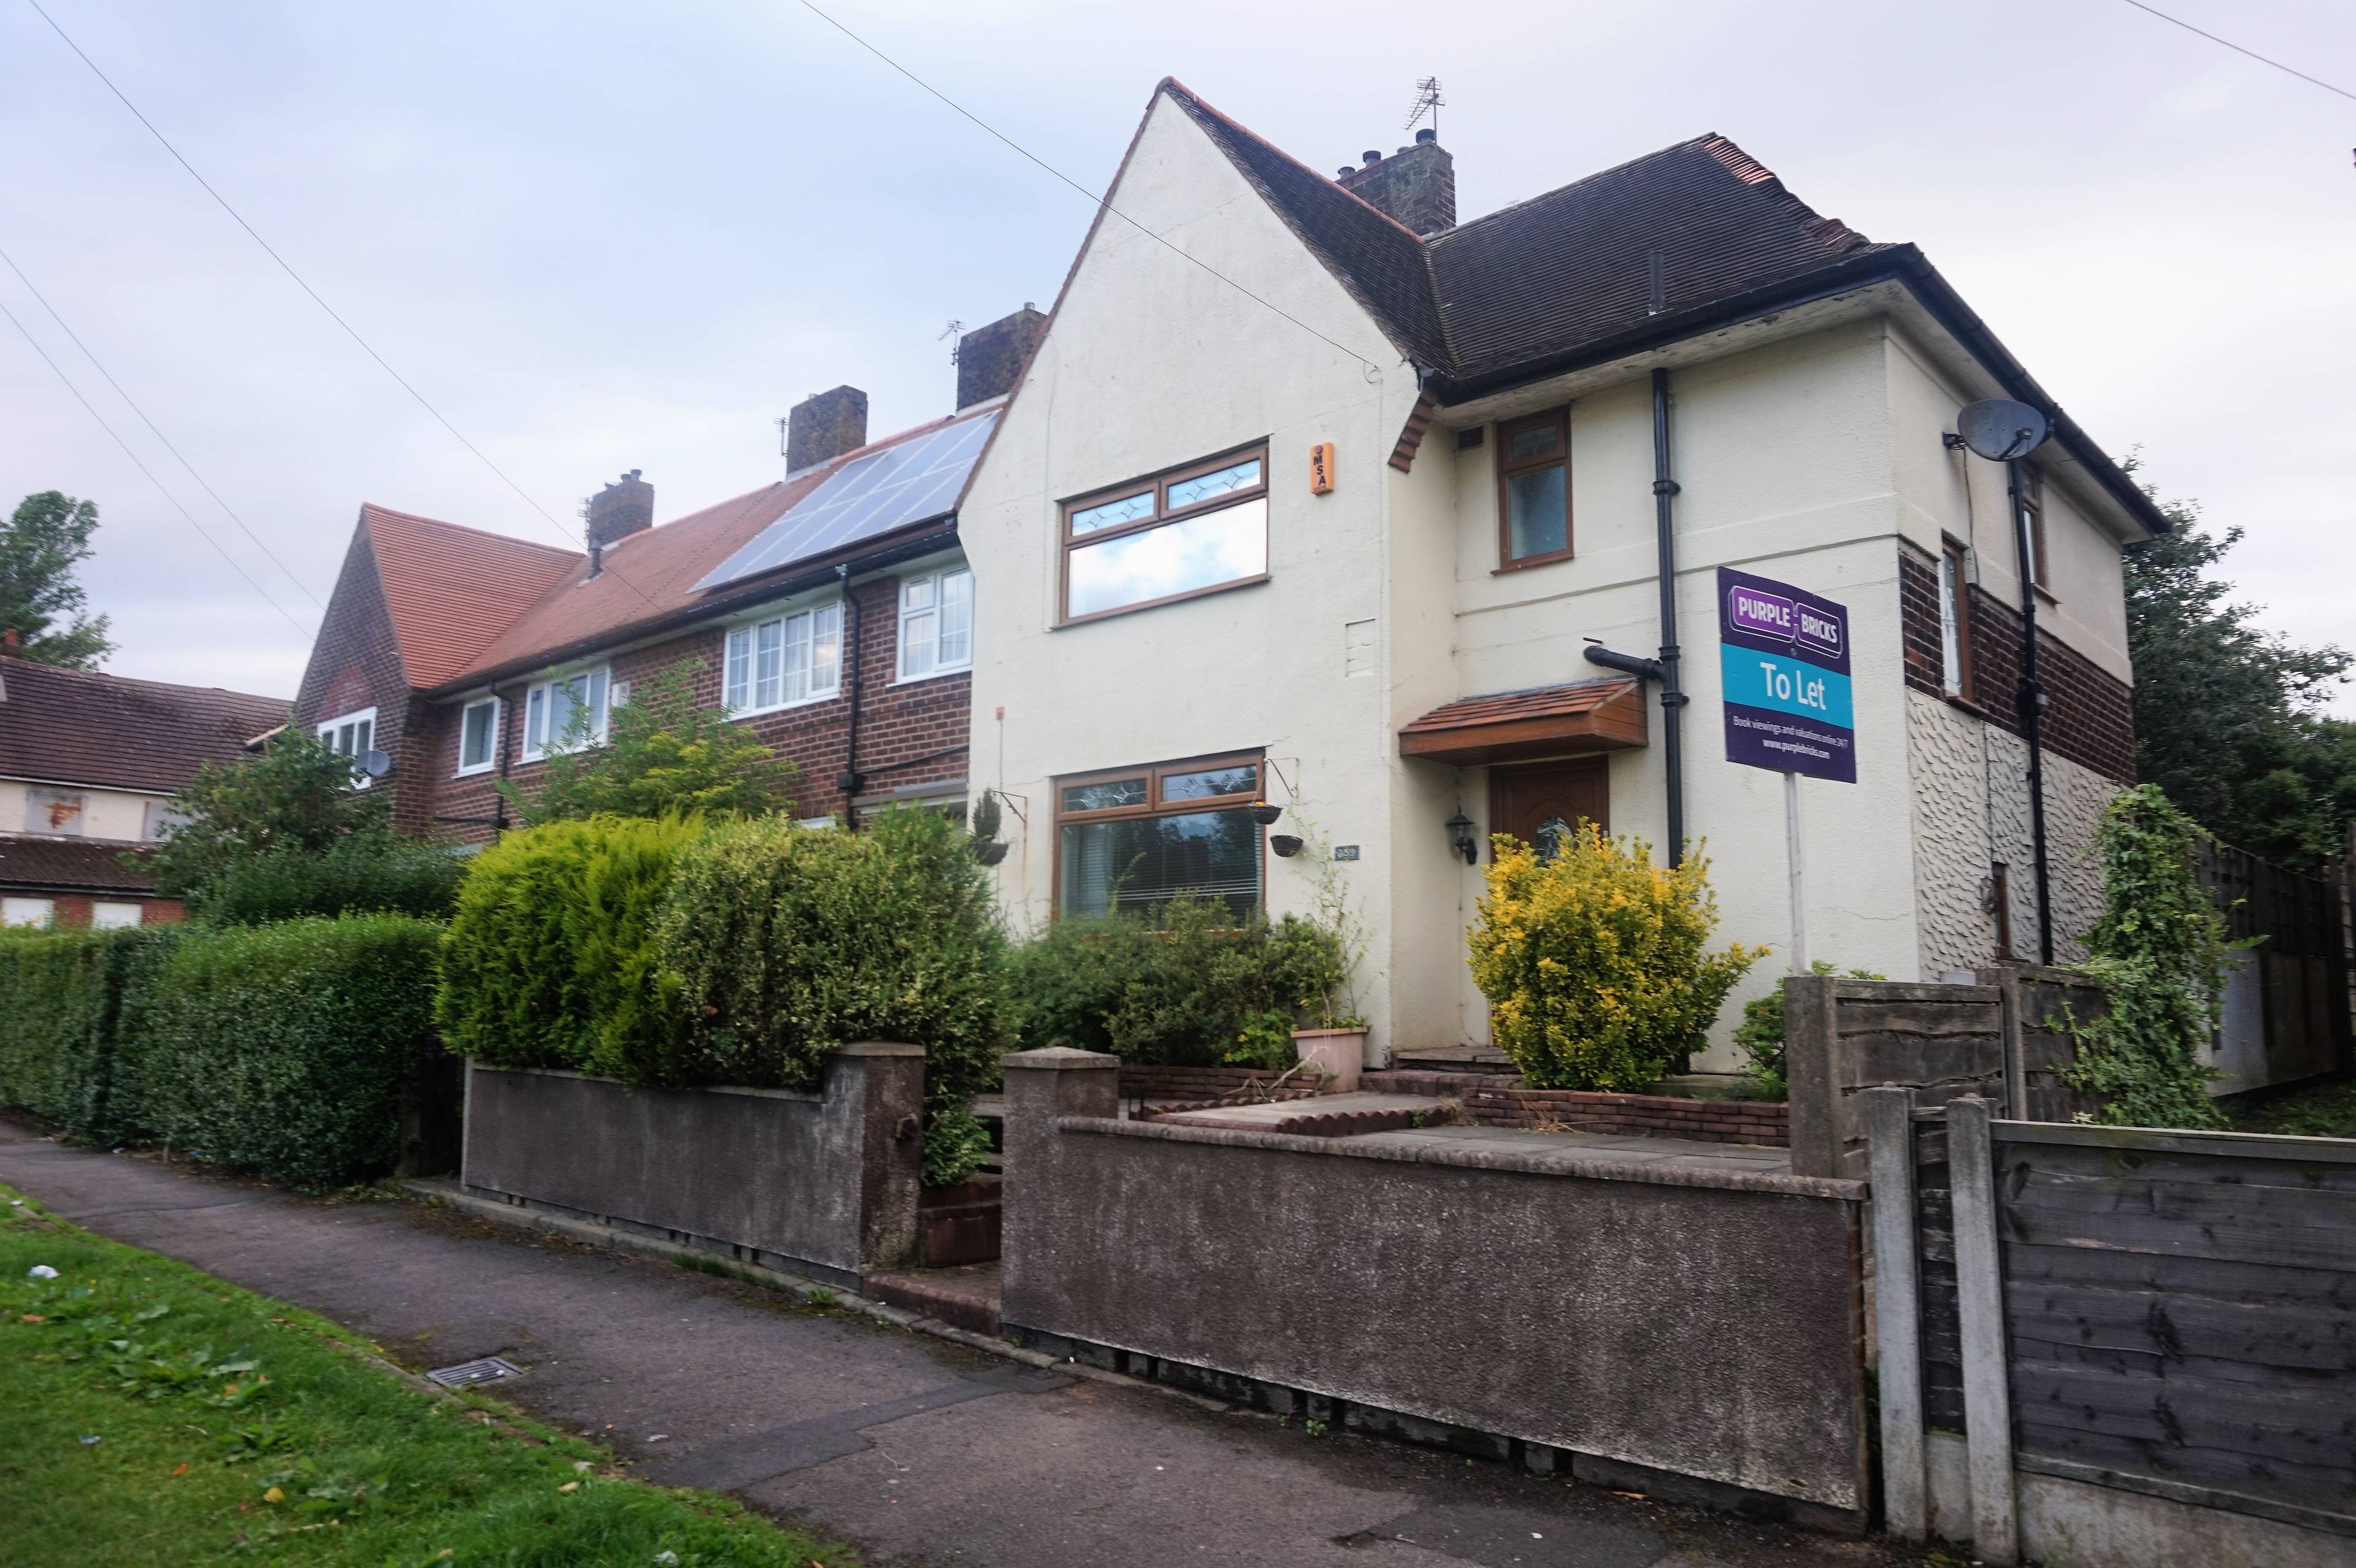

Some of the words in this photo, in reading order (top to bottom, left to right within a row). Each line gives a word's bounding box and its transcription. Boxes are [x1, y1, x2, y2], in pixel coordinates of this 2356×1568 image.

[1314, 455, 1326, 485] MSA
[1738, 596, 1791, 627] PURPLE
[1801, 613, 1838, 644] BRICKS
[1760, 662, 1791, 700] To
[1796, 670, 1827, 710] Let
[1733, 715, 1750, 728] Book
[1751, 720, 1782, 735] viewings
[1782, 726, 1795, 736] and
[1762, 739, 1830, 759] www.purplebricks.com
